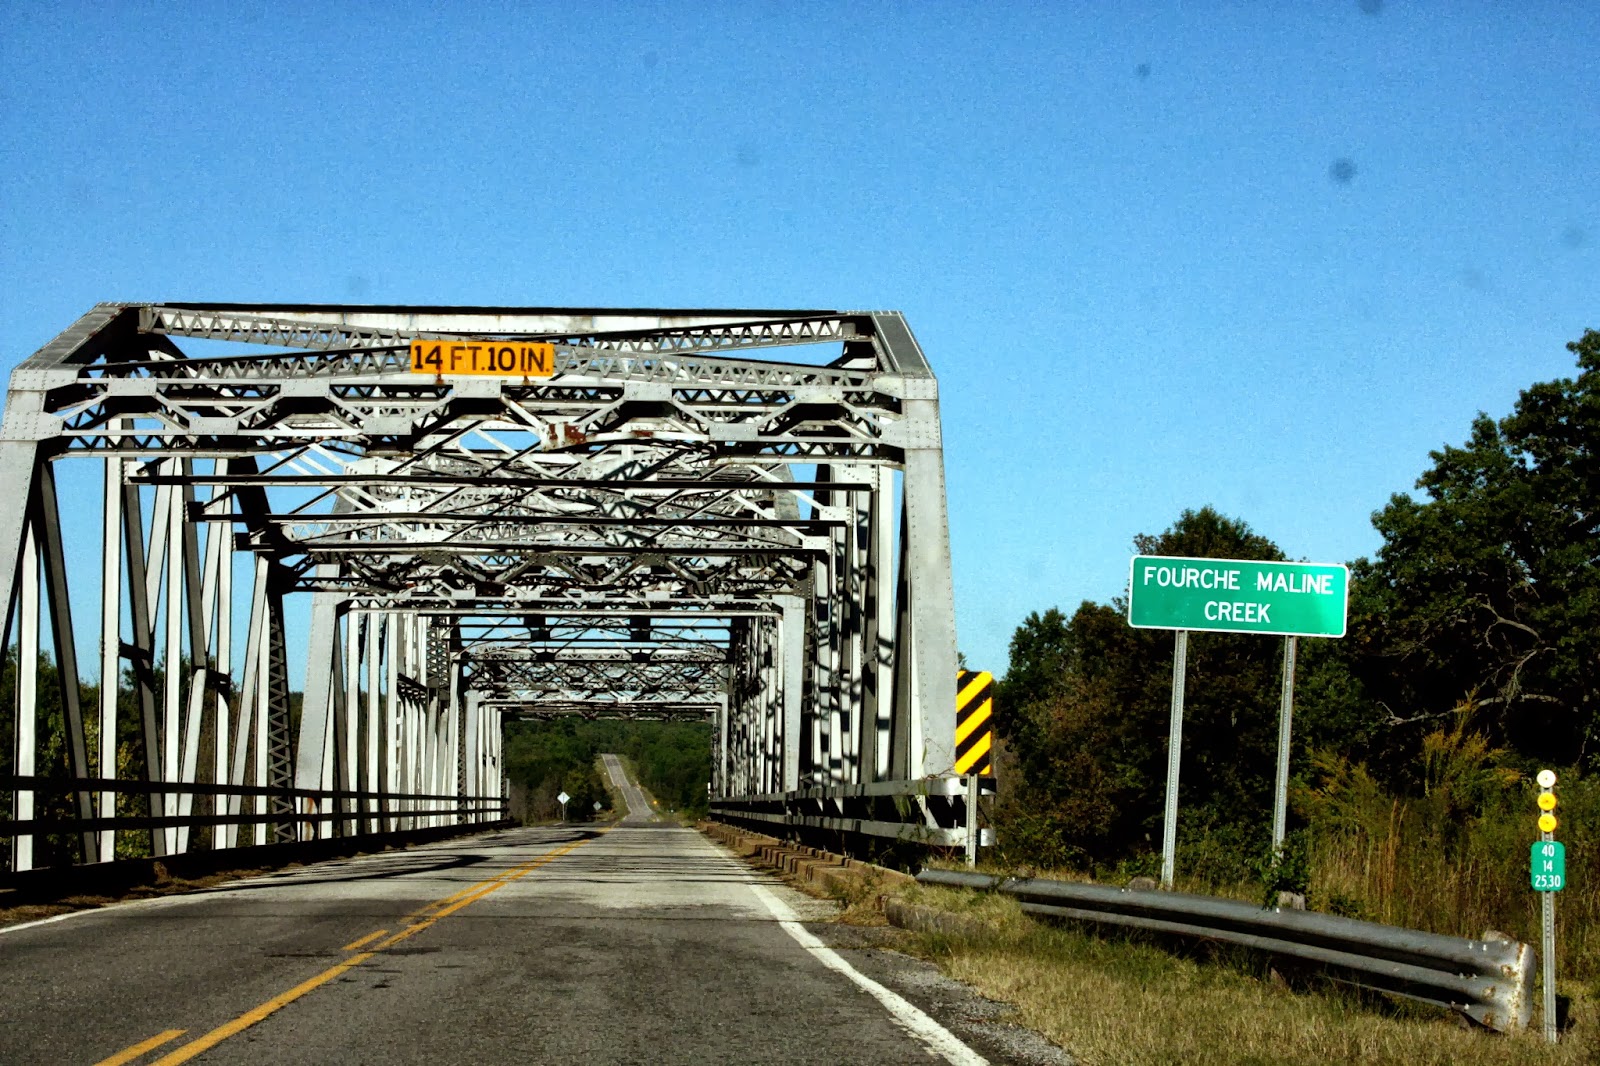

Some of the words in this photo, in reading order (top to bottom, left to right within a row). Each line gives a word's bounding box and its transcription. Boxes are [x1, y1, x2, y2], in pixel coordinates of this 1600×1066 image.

[414, 345, 443, 370] 14
[488, 346, 516, 371] 10
[1143, 566, 1240, 590] FOURCHE
[1256, 571, 1334, 595] MALINE
[1204, 600, 1271, 623] CREEK
[1541, 844, 1555, 857] 40
[1543, 860, 1553, 872] 14
